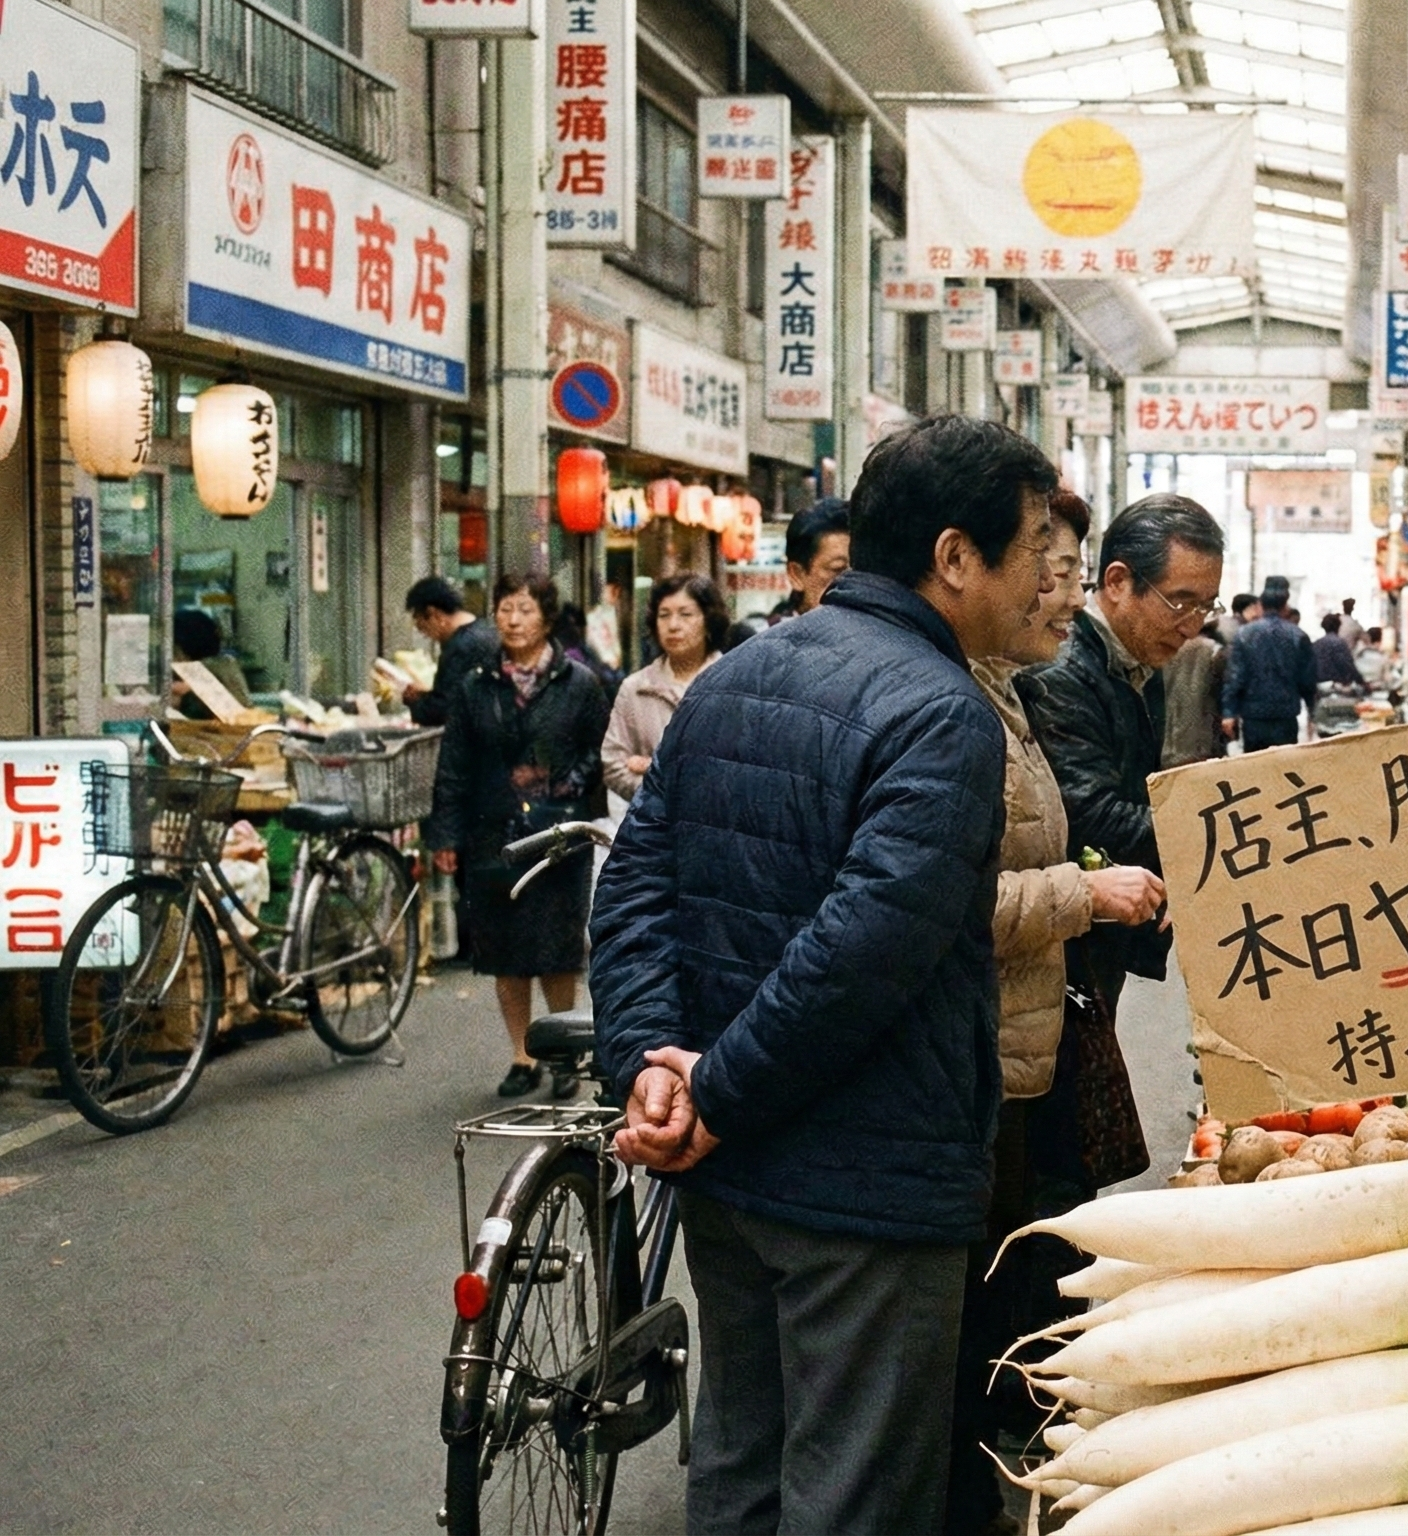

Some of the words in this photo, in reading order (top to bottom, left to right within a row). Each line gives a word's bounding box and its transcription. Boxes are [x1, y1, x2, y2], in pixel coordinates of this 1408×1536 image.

[556, 0, 608, 195] 主腰痛店
[291, 182, 450, 336] 田商店
